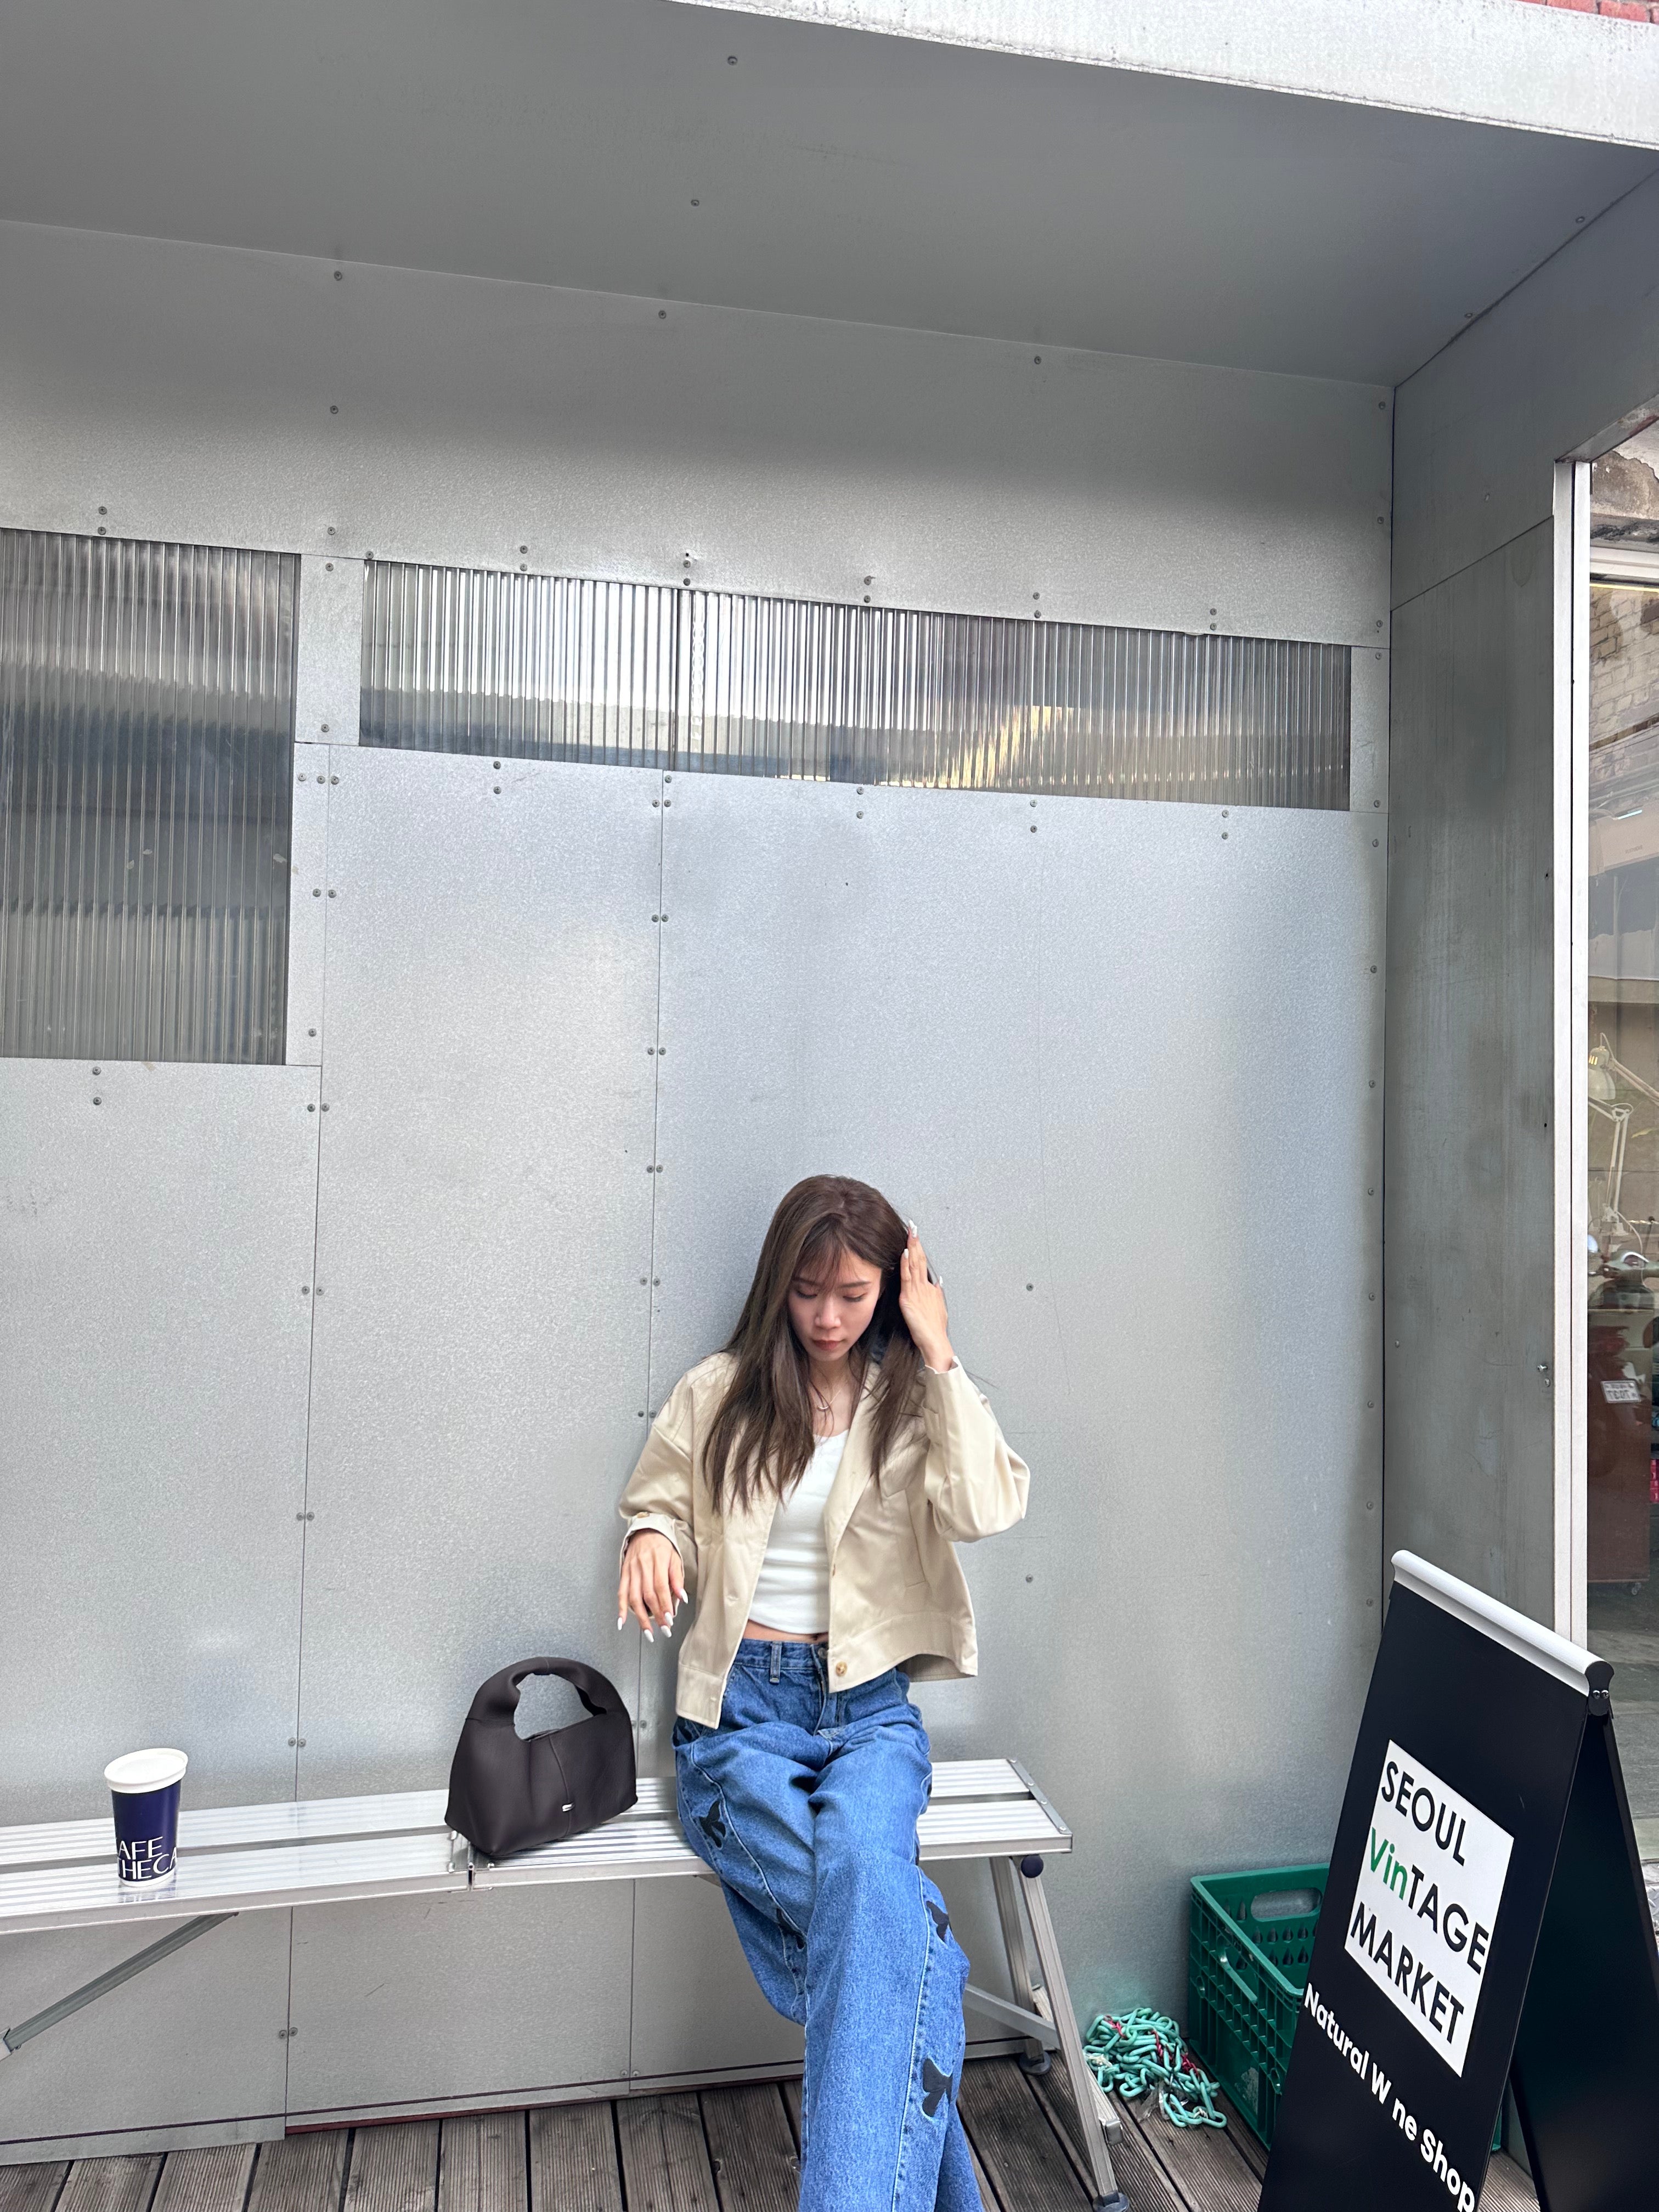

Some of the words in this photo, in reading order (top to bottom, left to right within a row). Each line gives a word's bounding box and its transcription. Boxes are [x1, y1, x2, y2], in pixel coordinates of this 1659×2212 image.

[1381, 1761, 1466, 1866] SEOUL
[1350, 1901, 1464, 2045] MARKET
[1371, 1827, 1489, 1976] VinTAGE
[1304, 1983, 1369, 2080] Natural
[1420, 2129, 1475, 2212] Shop
